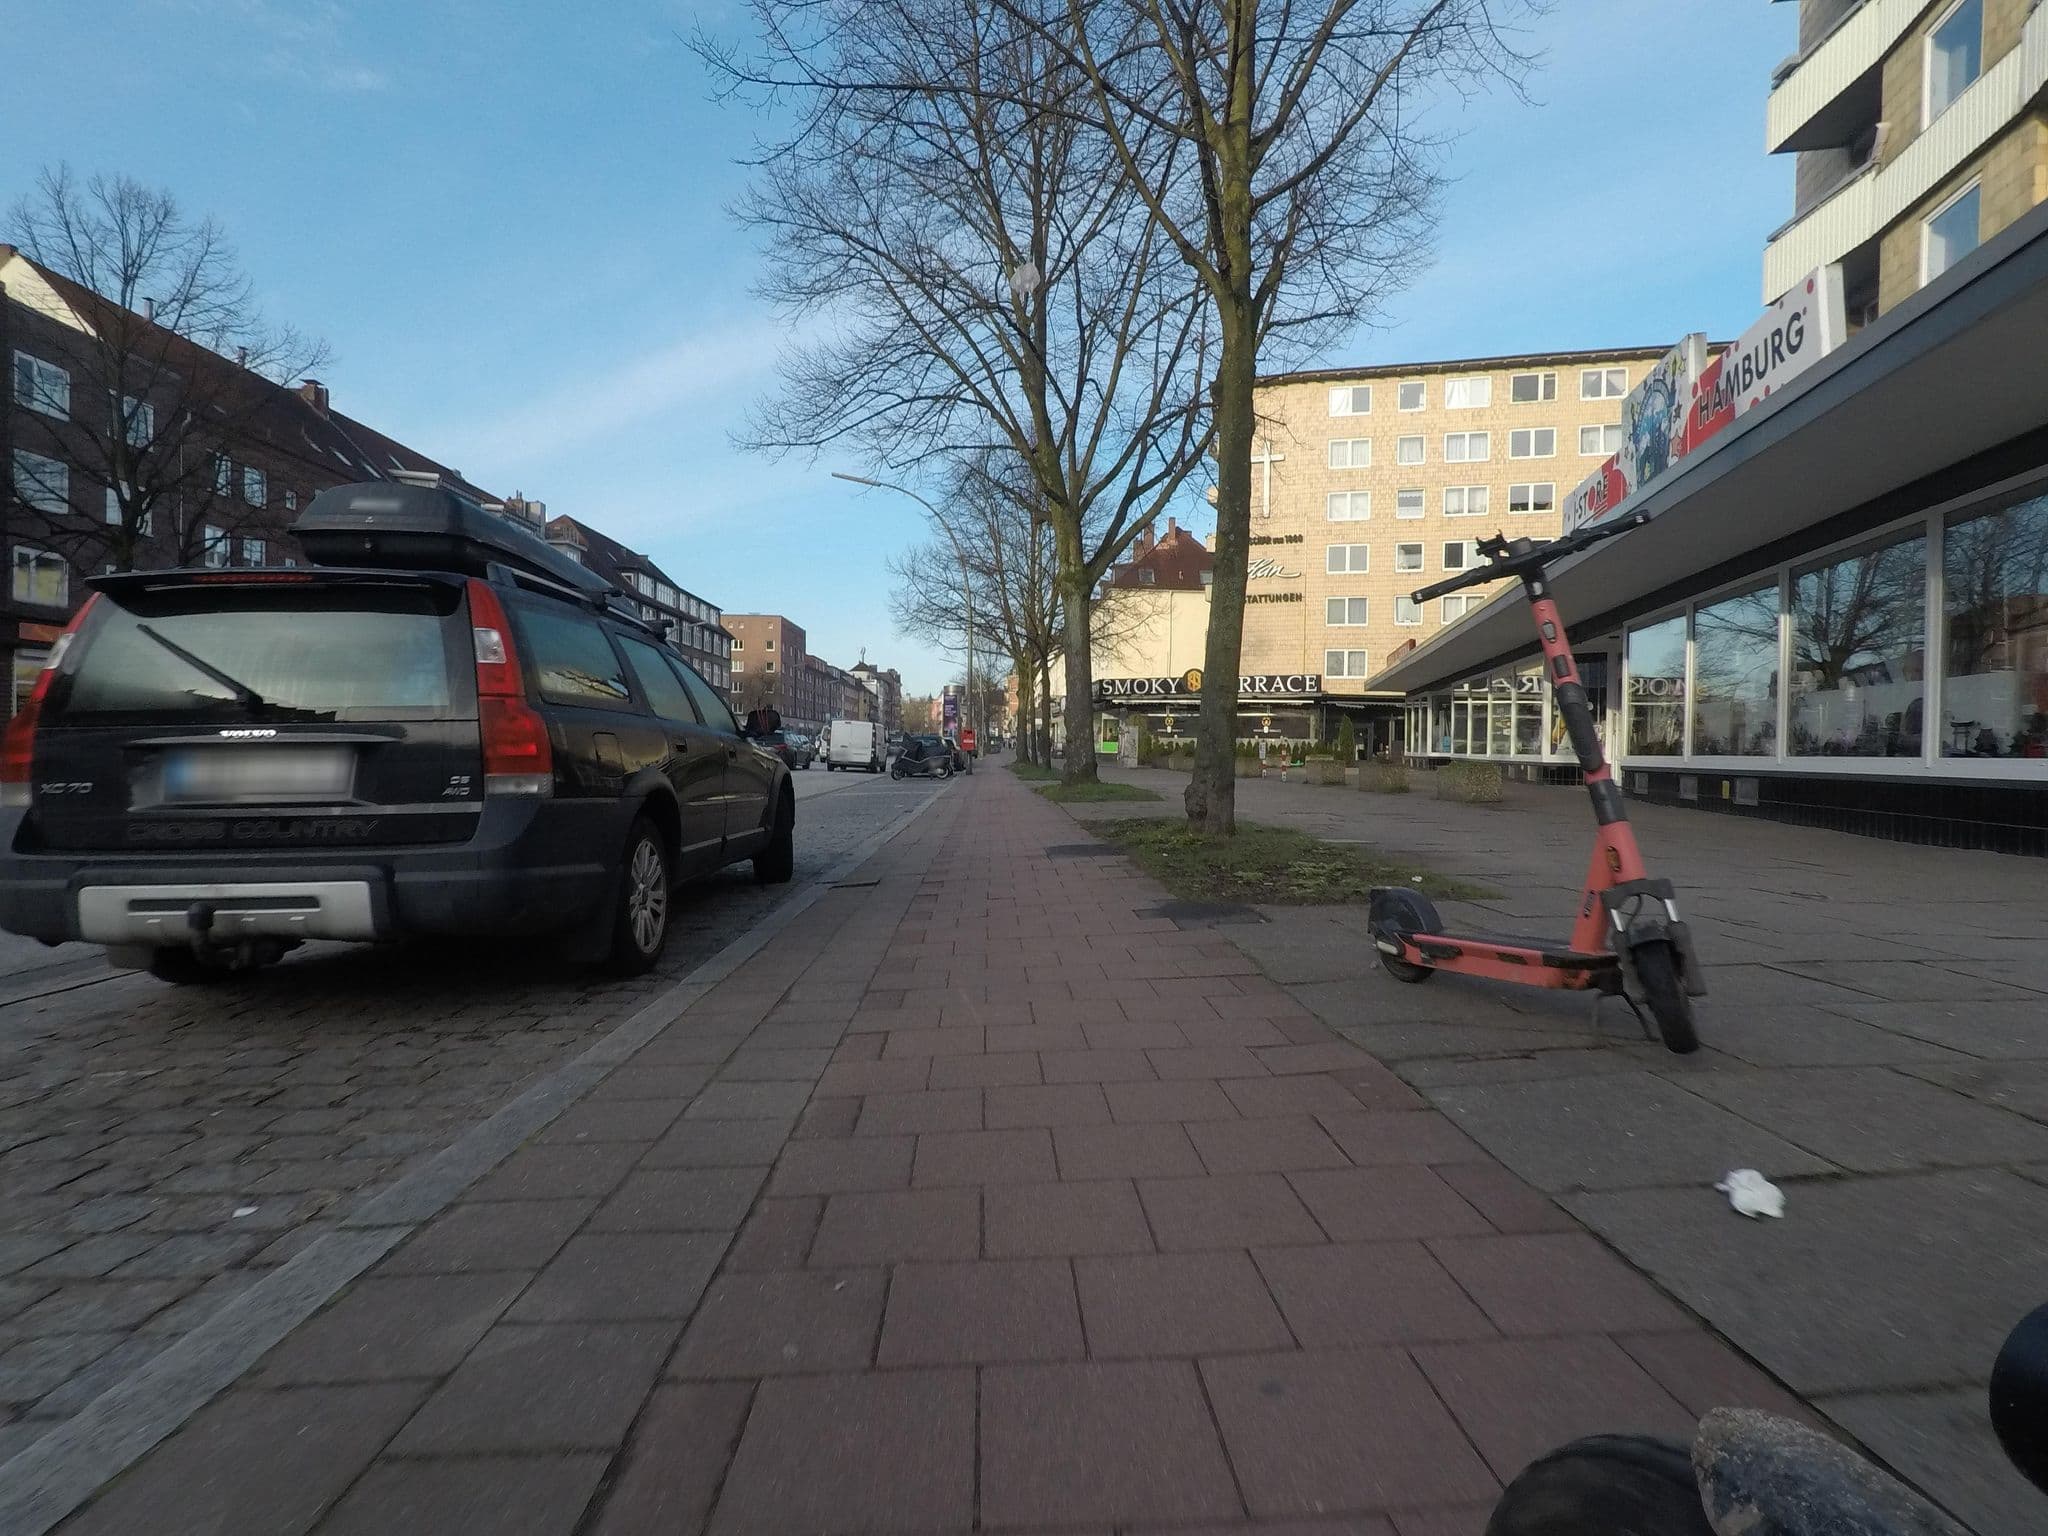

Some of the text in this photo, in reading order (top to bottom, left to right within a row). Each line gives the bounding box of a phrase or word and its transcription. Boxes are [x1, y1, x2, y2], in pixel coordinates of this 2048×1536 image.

[1698, 311, 1804, 430] HAMBURG
[1246, 592, 1302, 604] TATTUNGEN
[1102, 675, 1318, 695] SMOKY RRACE
[219, 729, 277, 739] VOLVO
